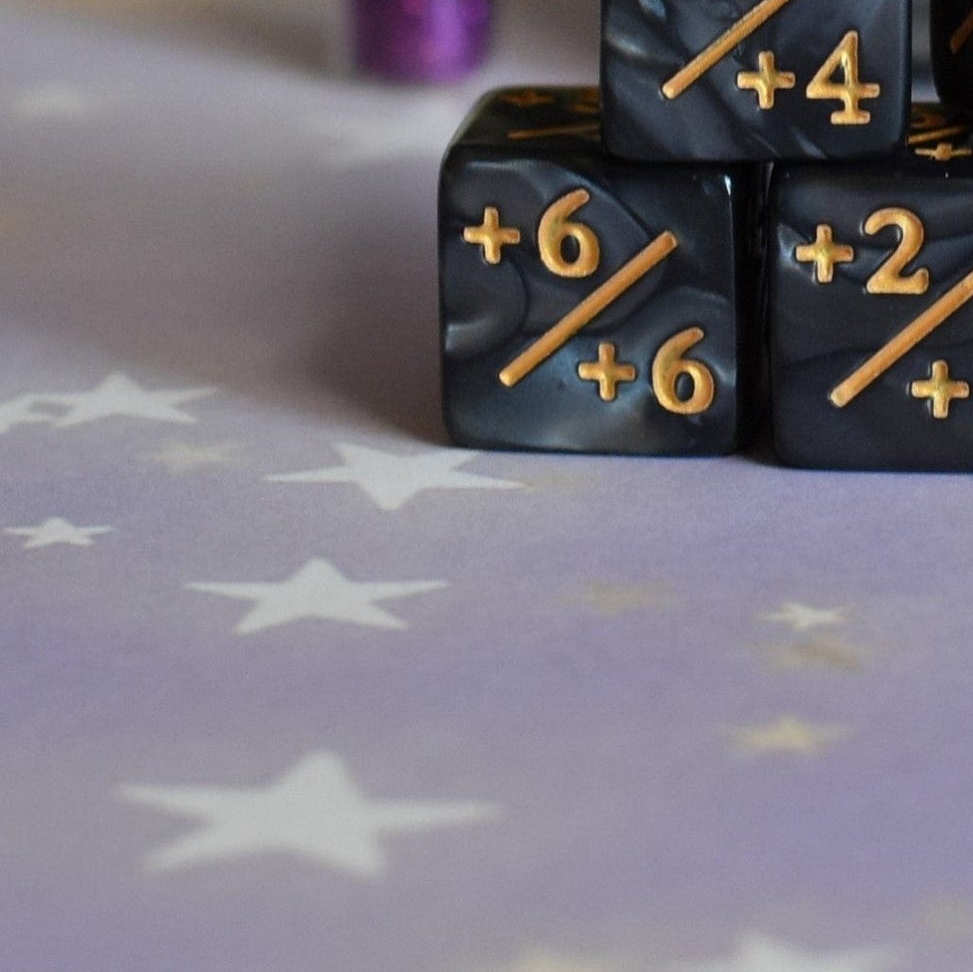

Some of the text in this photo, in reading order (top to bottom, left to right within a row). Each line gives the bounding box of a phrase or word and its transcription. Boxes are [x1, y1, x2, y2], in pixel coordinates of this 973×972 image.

[737, 30, 880, 124] +4
[463, 188, 600, 278] +6
[796, 206, 930, 295] +2
[578, 327, 715, 415] +6
